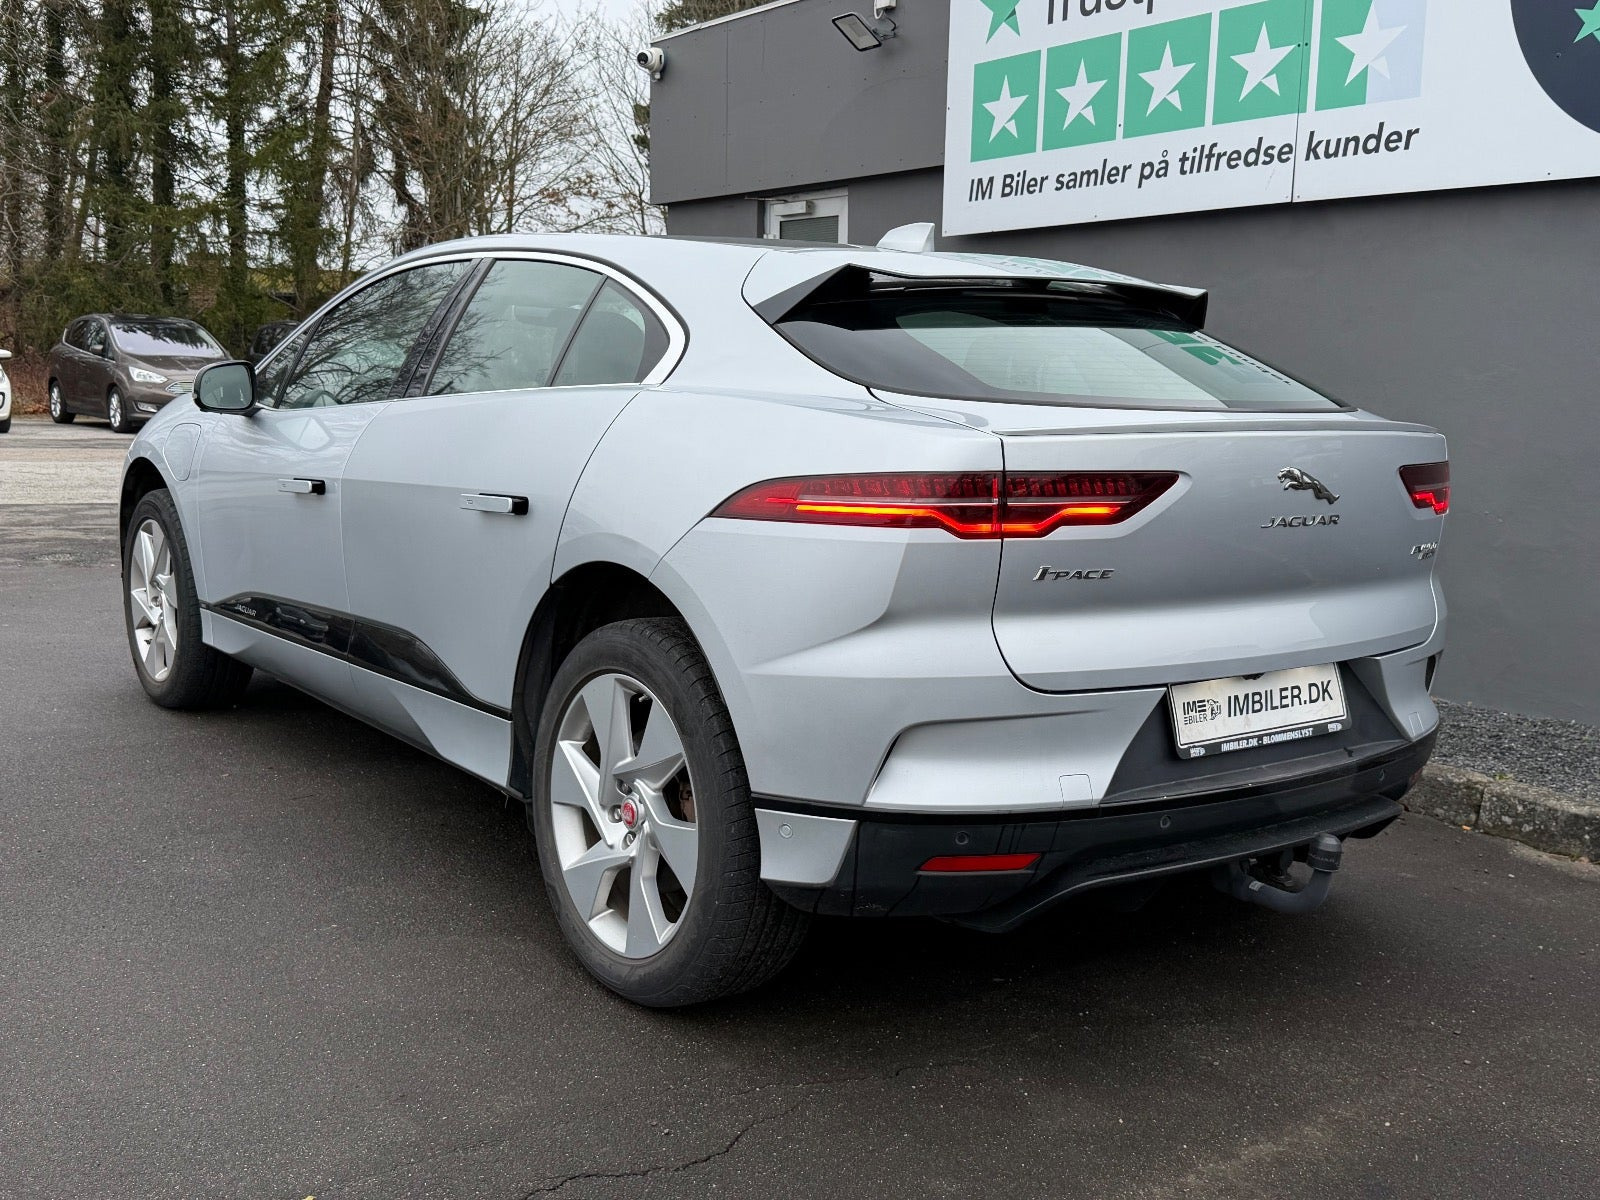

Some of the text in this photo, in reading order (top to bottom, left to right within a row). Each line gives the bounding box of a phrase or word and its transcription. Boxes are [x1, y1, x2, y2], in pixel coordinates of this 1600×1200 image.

[968, 121, 1420, 202] IM Biler samler på tilfredse kunder
[1260, 513, 1340, 529] JAGUAR
[234, 604, 256, 616] JAGUAR
[1228, 681, 1333, 717] IMBILER.DK
[1221, 739, 1258, 752] IMBILER.DK
[1263, 728, 1313, 743] BLOMMENSLYST
